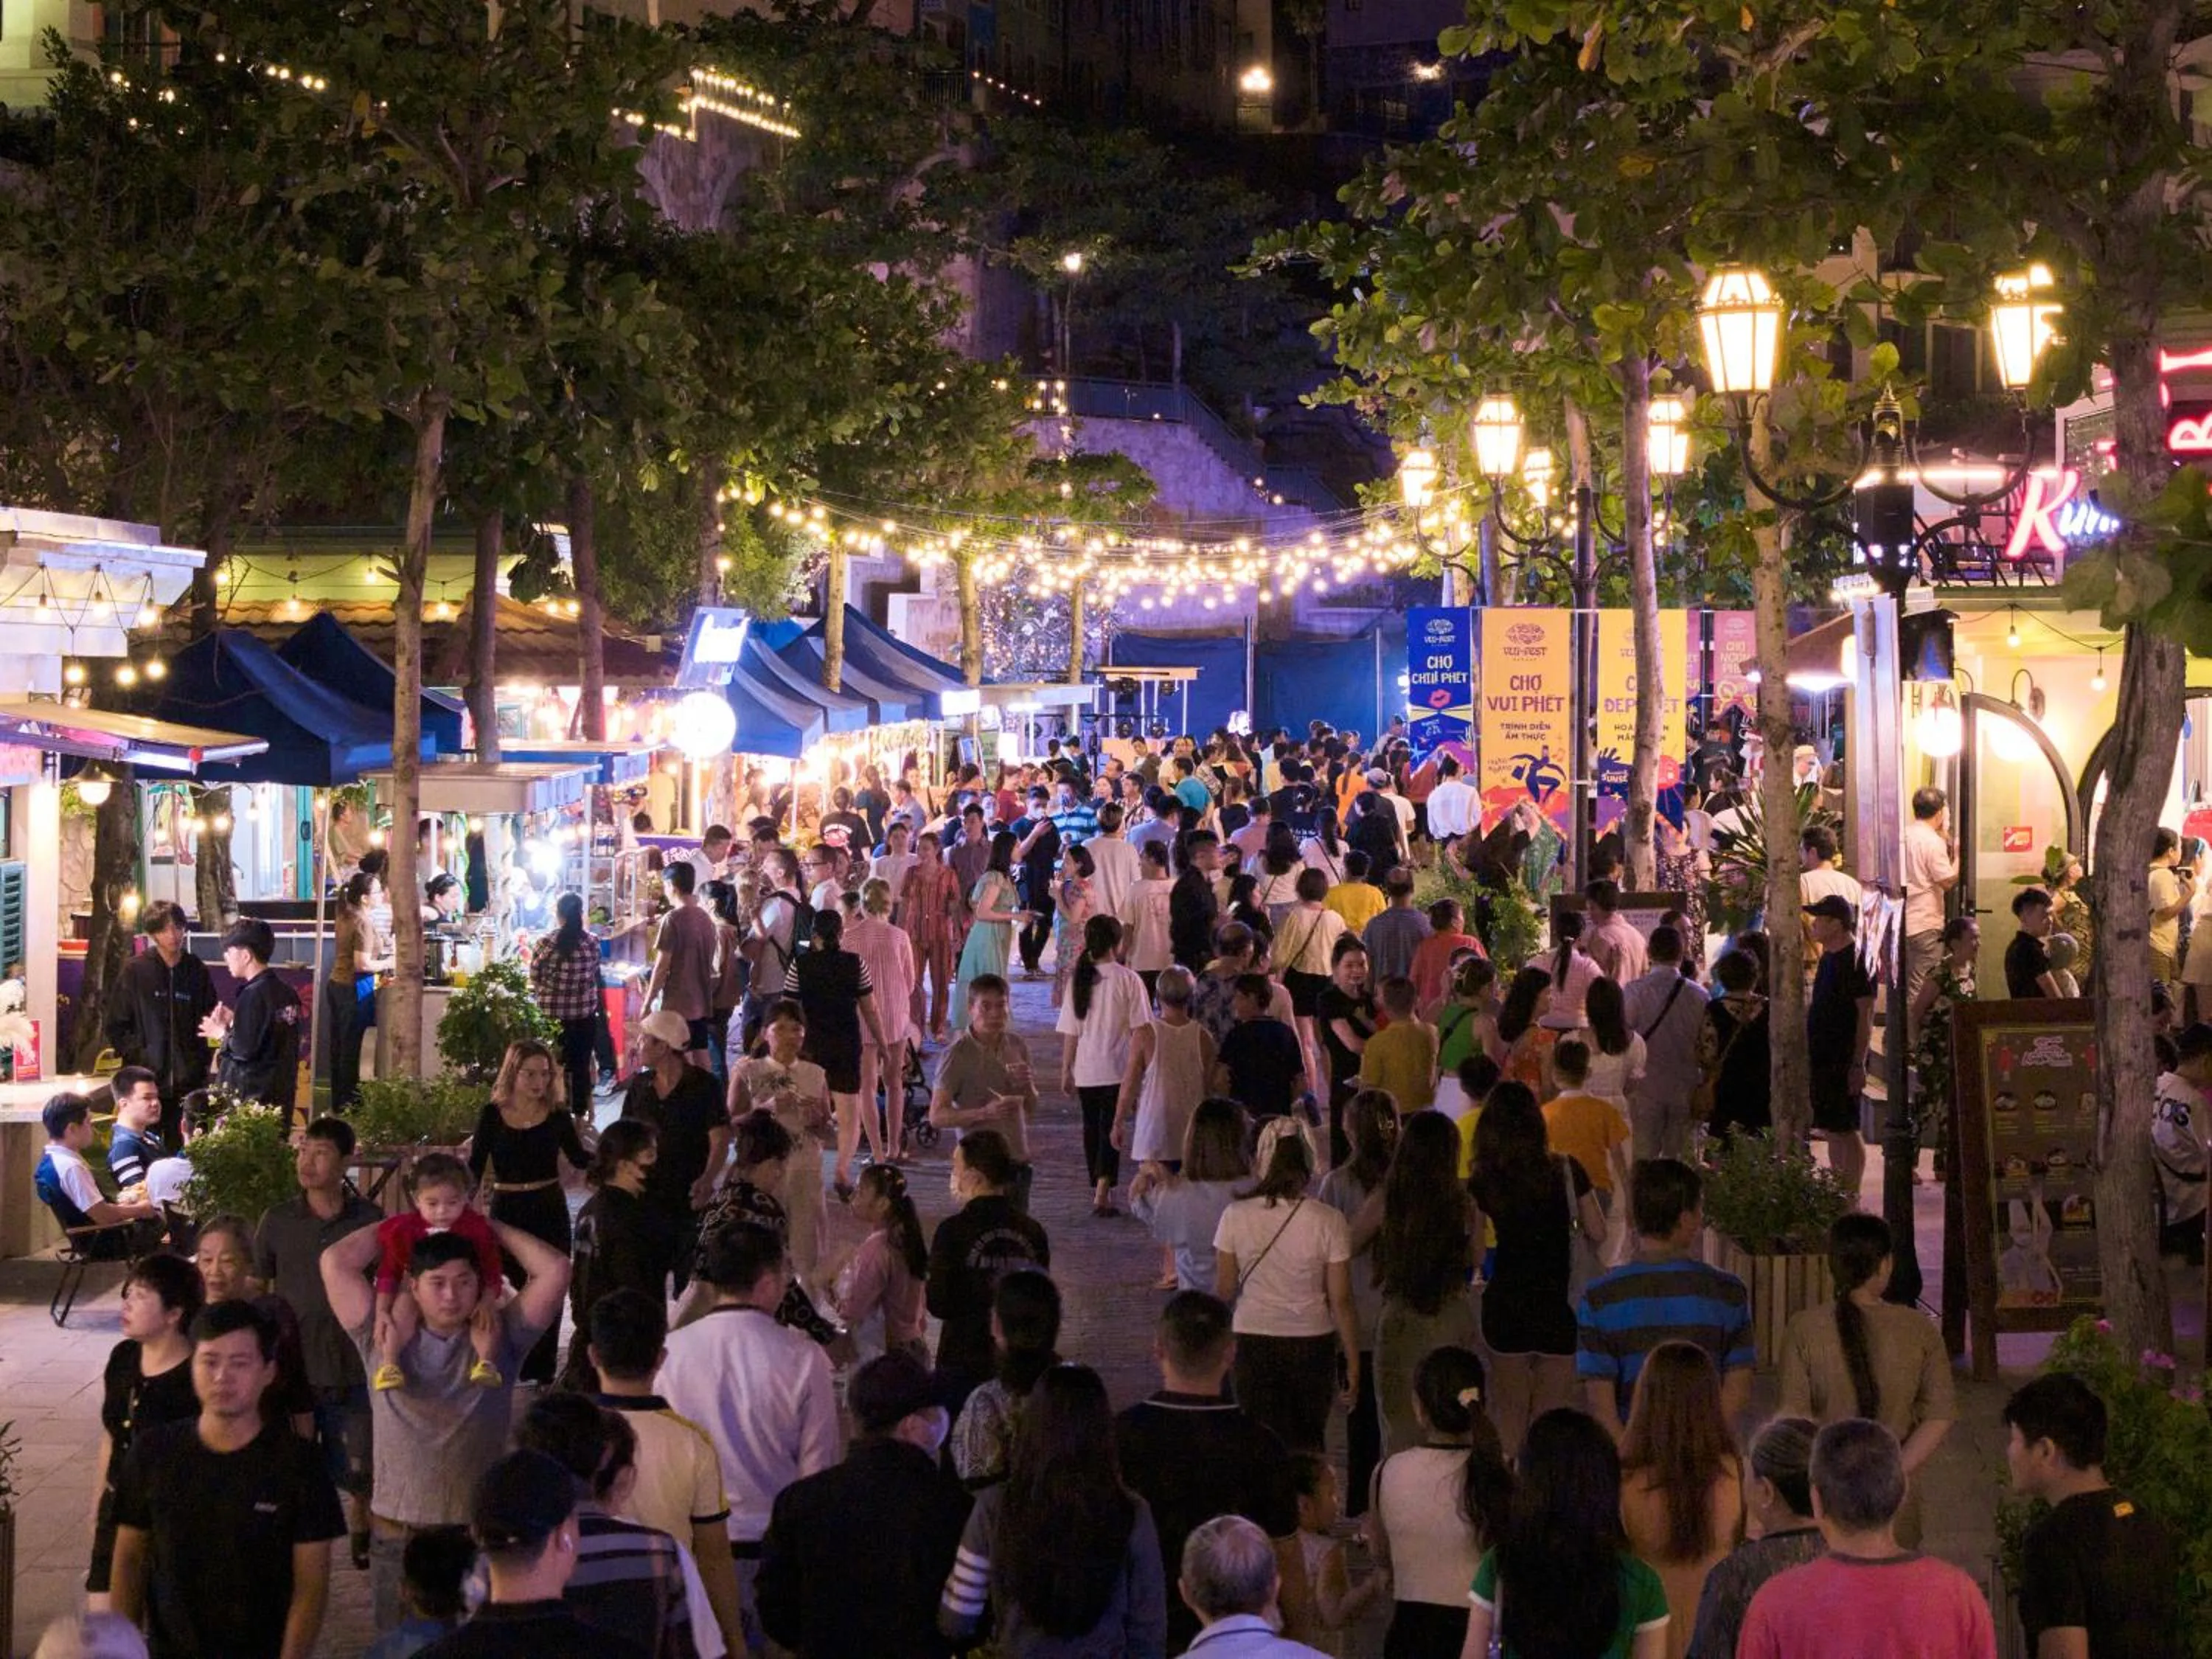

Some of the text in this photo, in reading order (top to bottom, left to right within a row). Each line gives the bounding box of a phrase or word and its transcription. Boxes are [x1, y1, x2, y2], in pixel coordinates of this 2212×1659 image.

[1427, 655, 1453, 672] CHỢ
[1509, 674, 1543, 694] CHỢ
[1486, 695, 1518, 712] VUI
